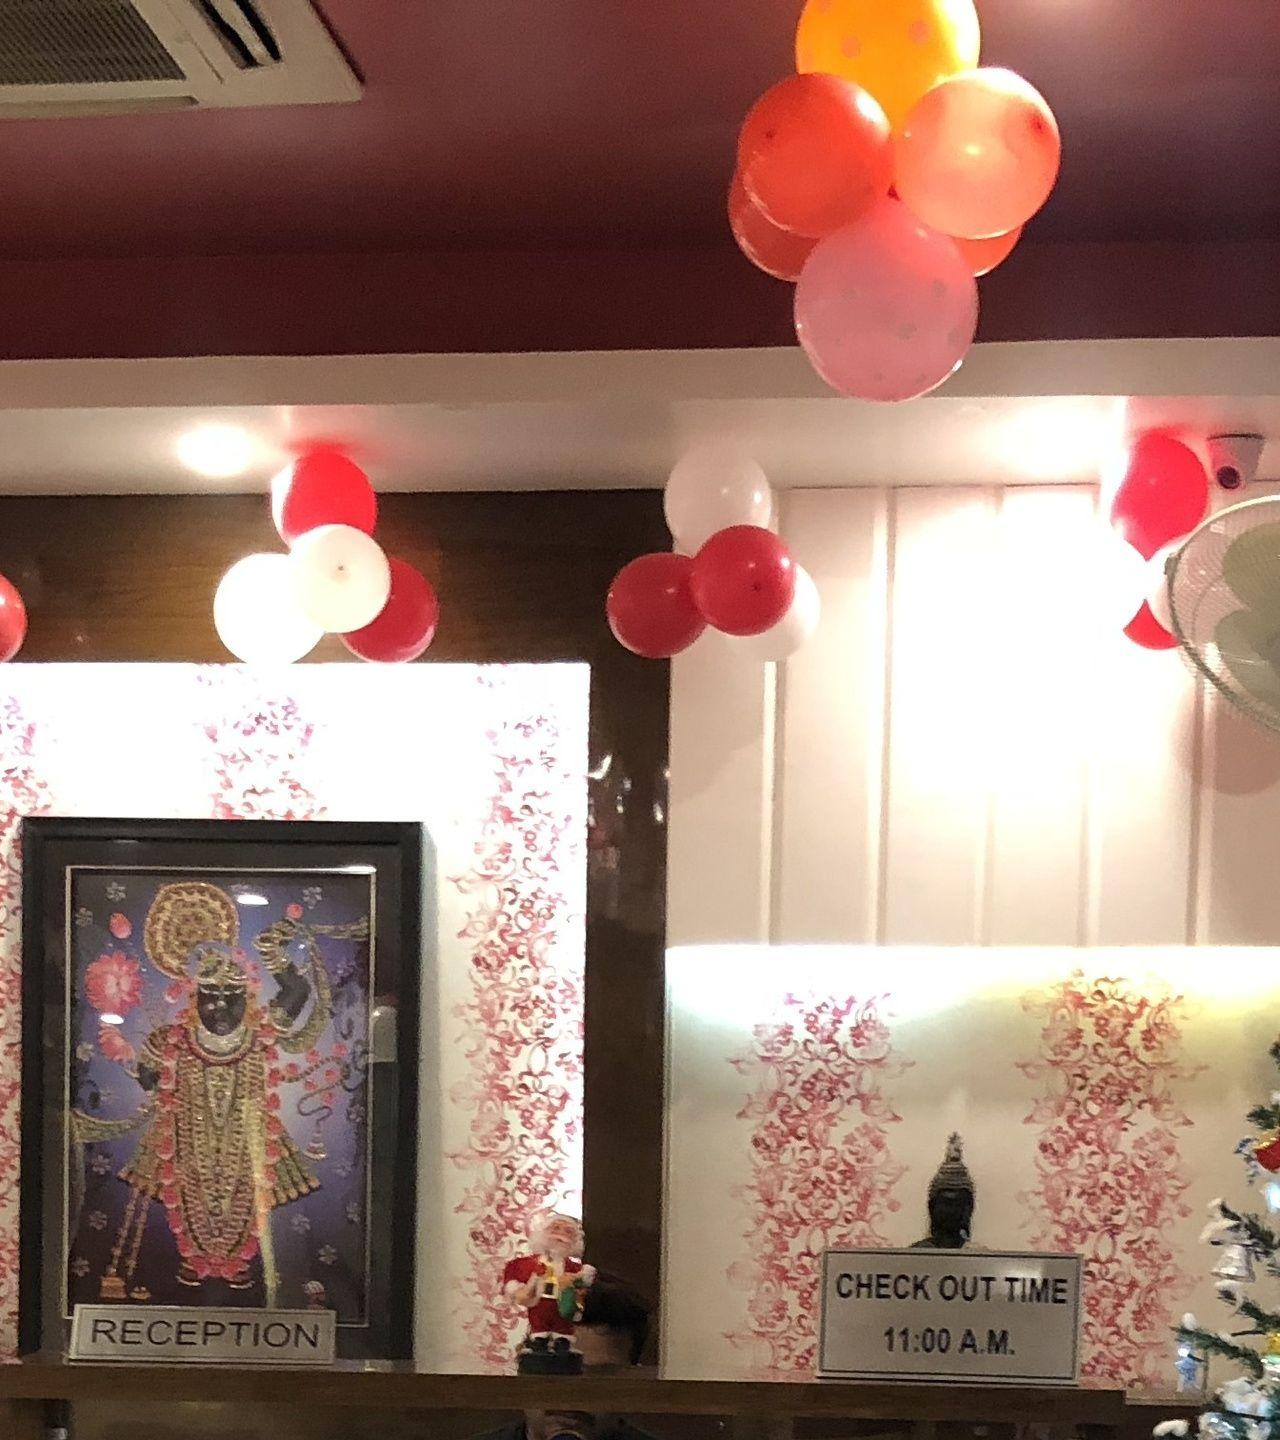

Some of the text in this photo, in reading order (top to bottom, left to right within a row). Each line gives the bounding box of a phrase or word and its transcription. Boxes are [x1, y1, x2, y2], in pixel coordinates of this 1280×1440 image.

[836, 1273, 1069, 1304] CHECK OUT TIME
[91, 1318, 320, 1348] RECEPTION
[883, 1326, 1016, 1356] 11:00 A.M.
